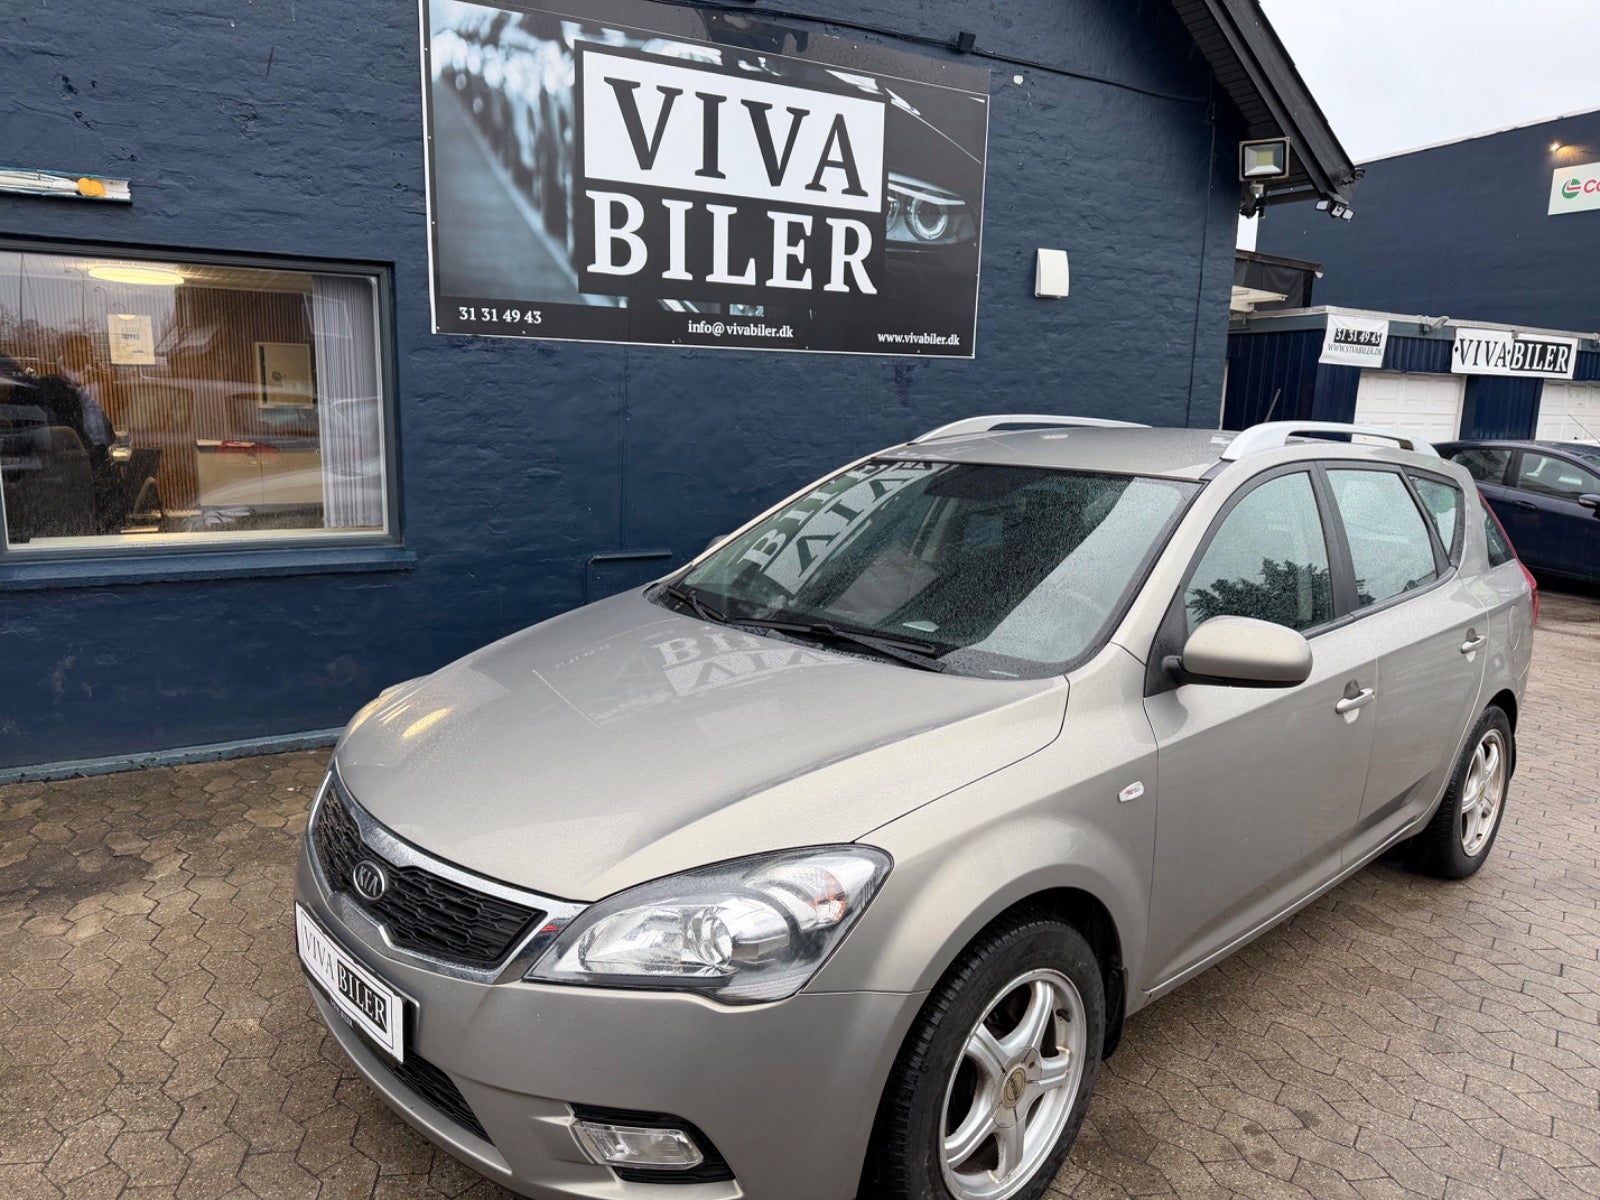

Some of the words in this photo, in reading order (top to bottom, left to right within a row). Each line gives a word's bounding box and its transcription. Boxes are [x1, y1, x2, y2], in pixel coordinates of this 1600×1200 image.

[603, 76, 869, 198] VIVA
[585, 189, 877, 295] BILER
[458, 306, 477, 321] 31
[482, 307, 498, 322] 31
[502, 308, 521, 323] 49
[524, 310, 542, 324] 43
[877, 331, 960, 346] www.vivabiler.dk
[1459, 338, 1508, 367] VIVA
[1510, 342, 1569, 372] BILER
[357, 866, 378, 896] KIA
[304, 925, 335, 982] VIVA
[337, 963, 388, 1029] BILER
